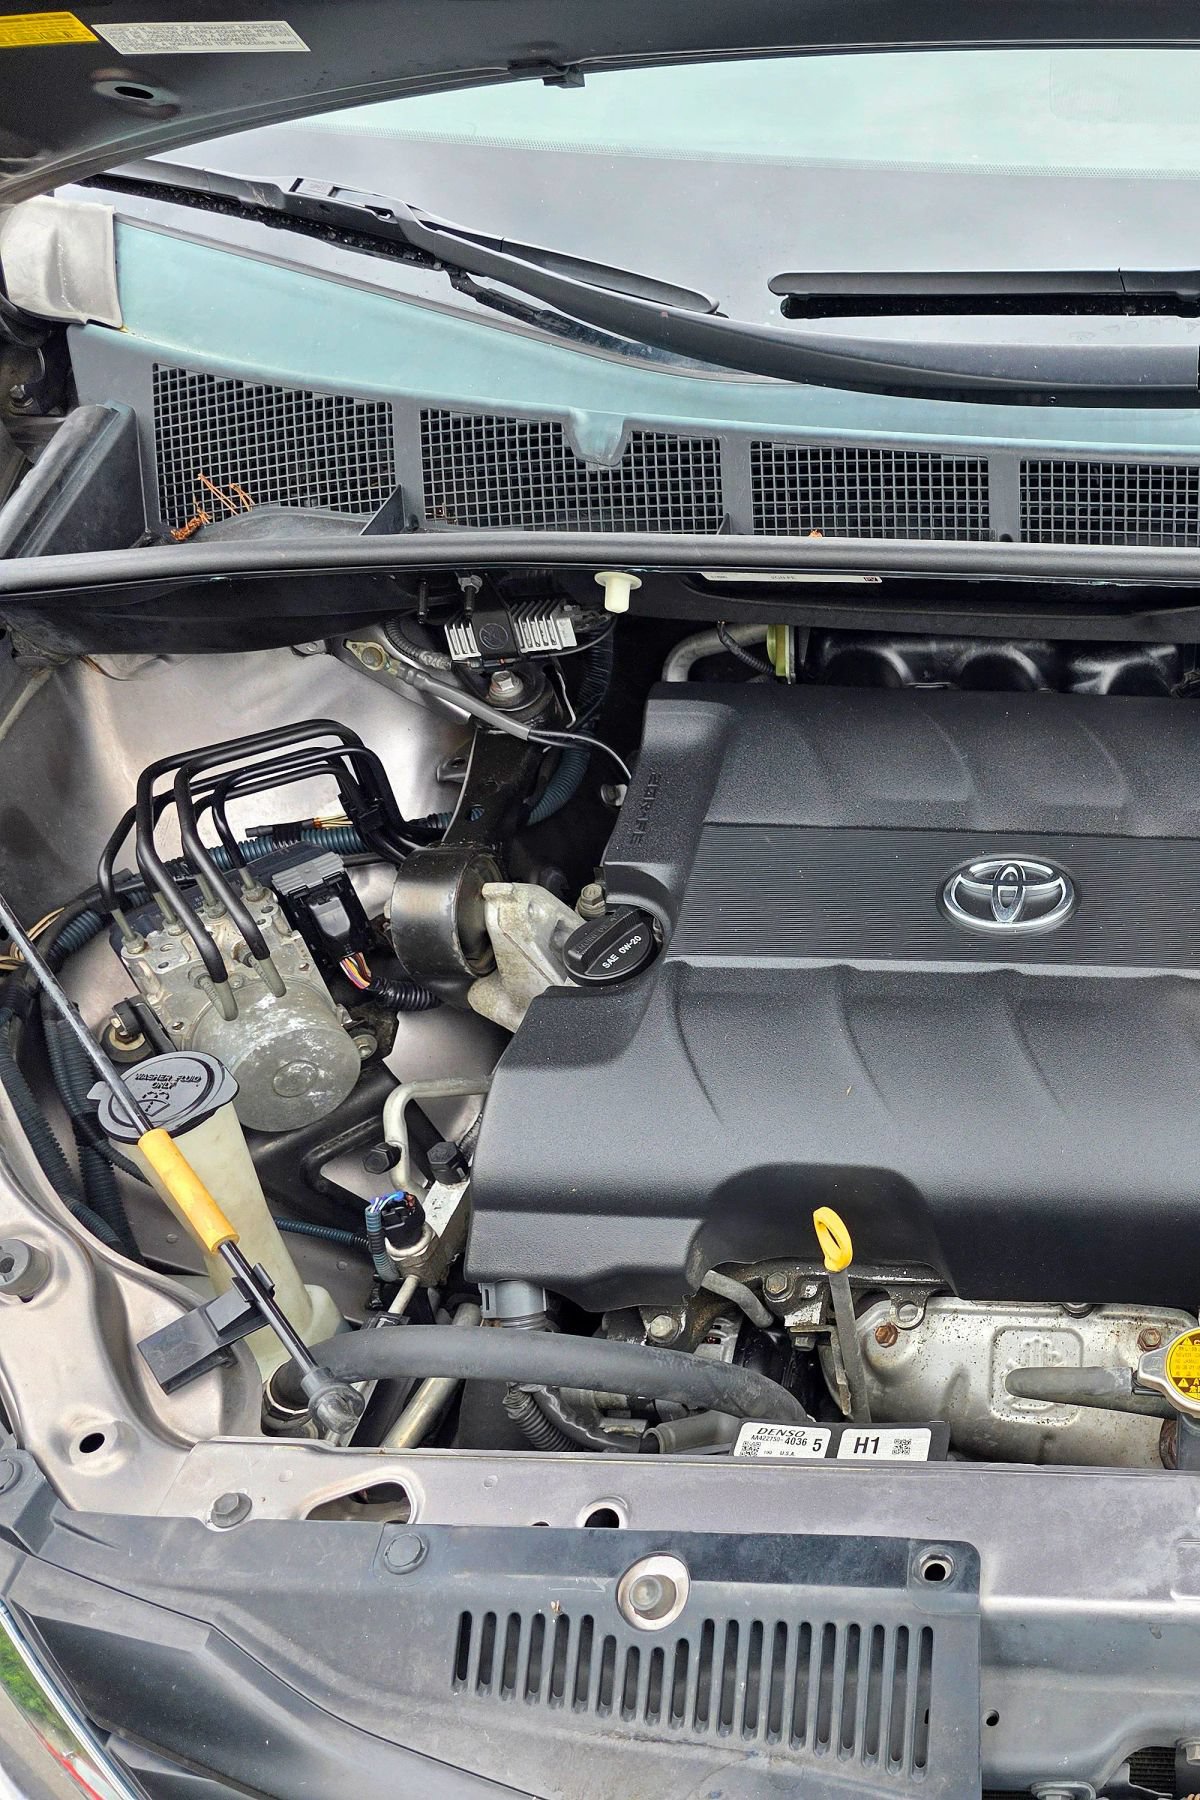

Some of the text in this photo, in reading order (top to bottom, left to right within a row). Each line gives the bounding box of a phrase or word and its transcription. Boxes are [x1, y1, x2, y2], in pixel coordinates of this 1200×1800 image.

[602, 935, 642, 969] SAE 0W-20
[135, 1073, 202, 1083] WASHER FLUID
[152, 1081, 177, 1090] ONLY
[757, 1427, 806, 1438] DENSO
[812, 1438, 823, 1452] 5
[853, 1436, 881, 1455] H1
